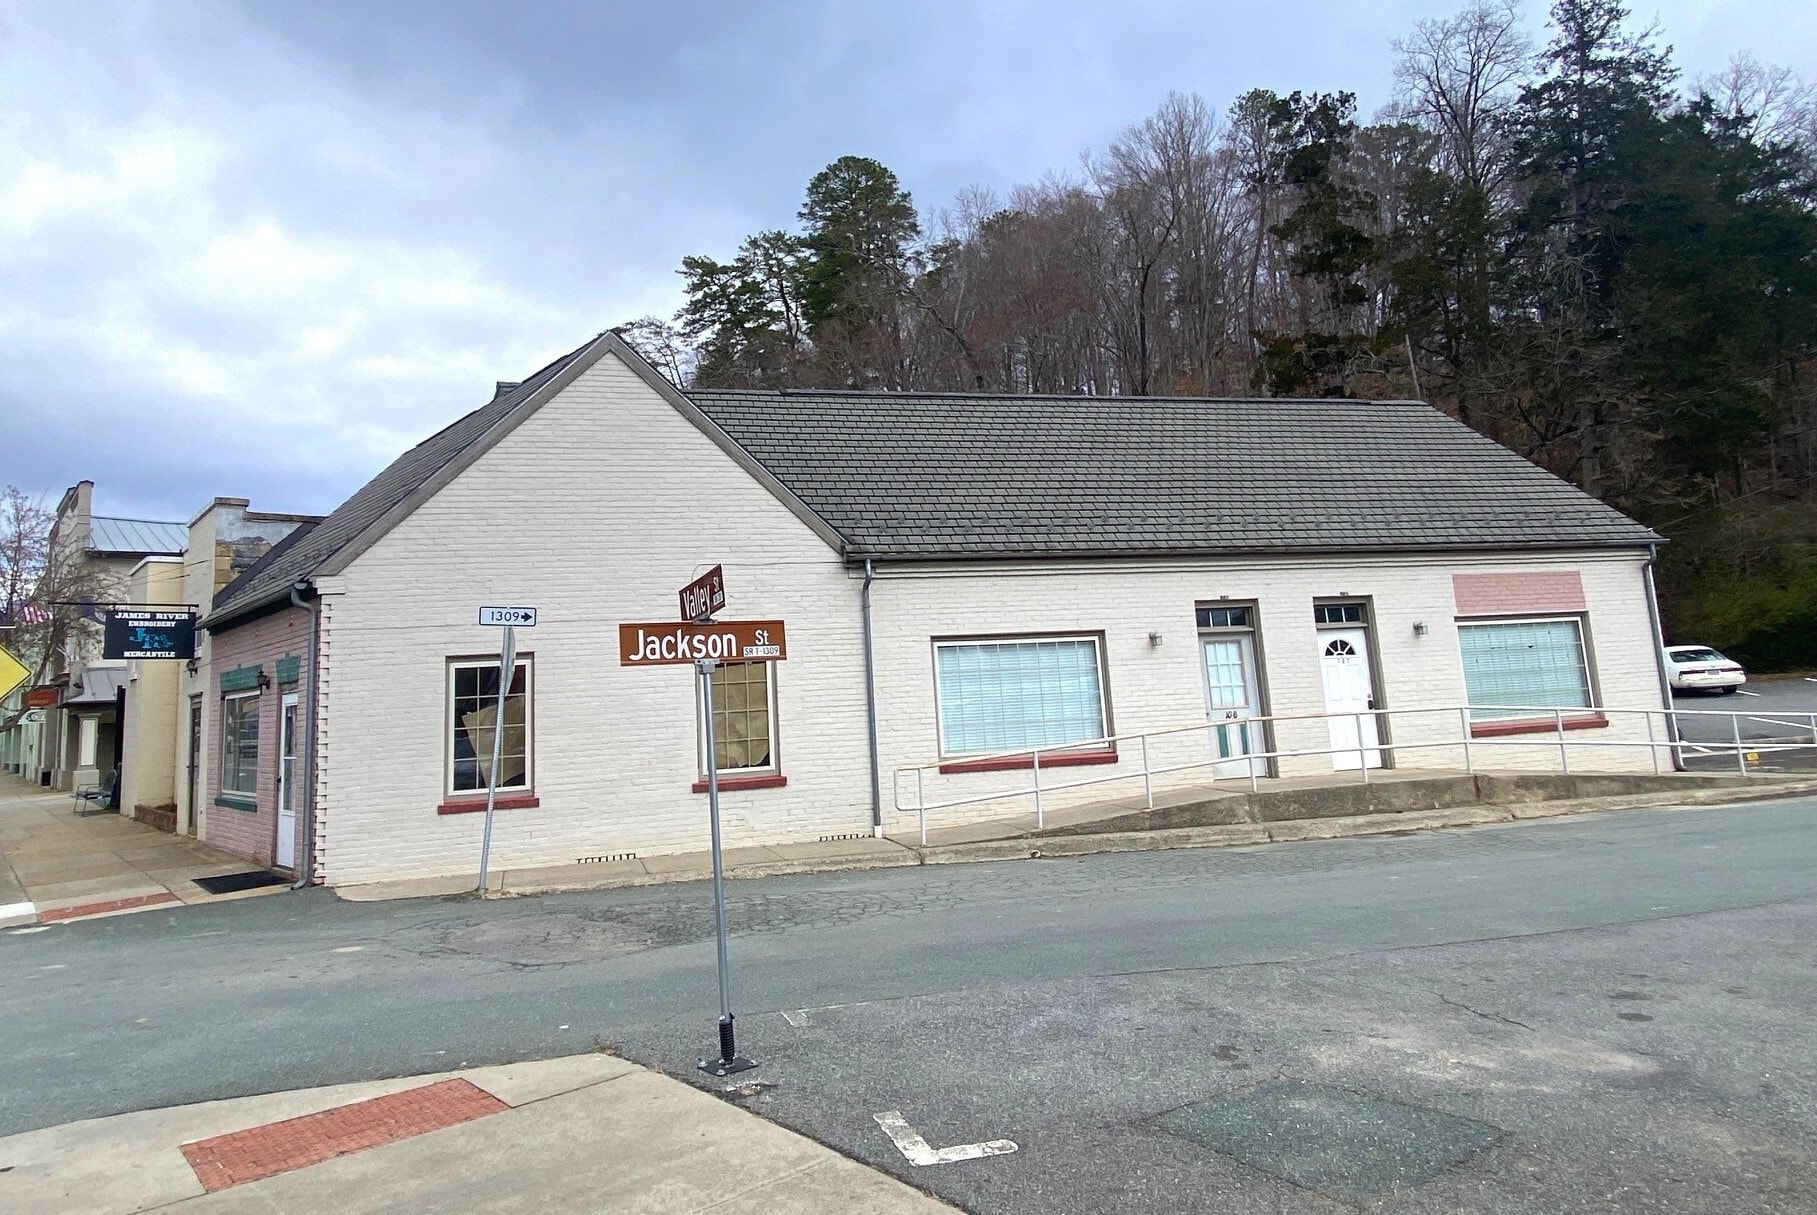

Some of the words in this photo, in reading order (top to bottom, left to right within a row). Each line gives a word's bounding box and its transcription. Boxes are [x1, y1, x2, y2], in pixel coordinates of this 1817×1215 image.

[683, 585, 710, 619] Valley
[713, 576, 720, 592] St
[491, 611, 519, 621] 1309
[629, 629, 736, 661] Jackson
[755, 629, 769, 645] St
[755, 646, 778, 655] T-1309
